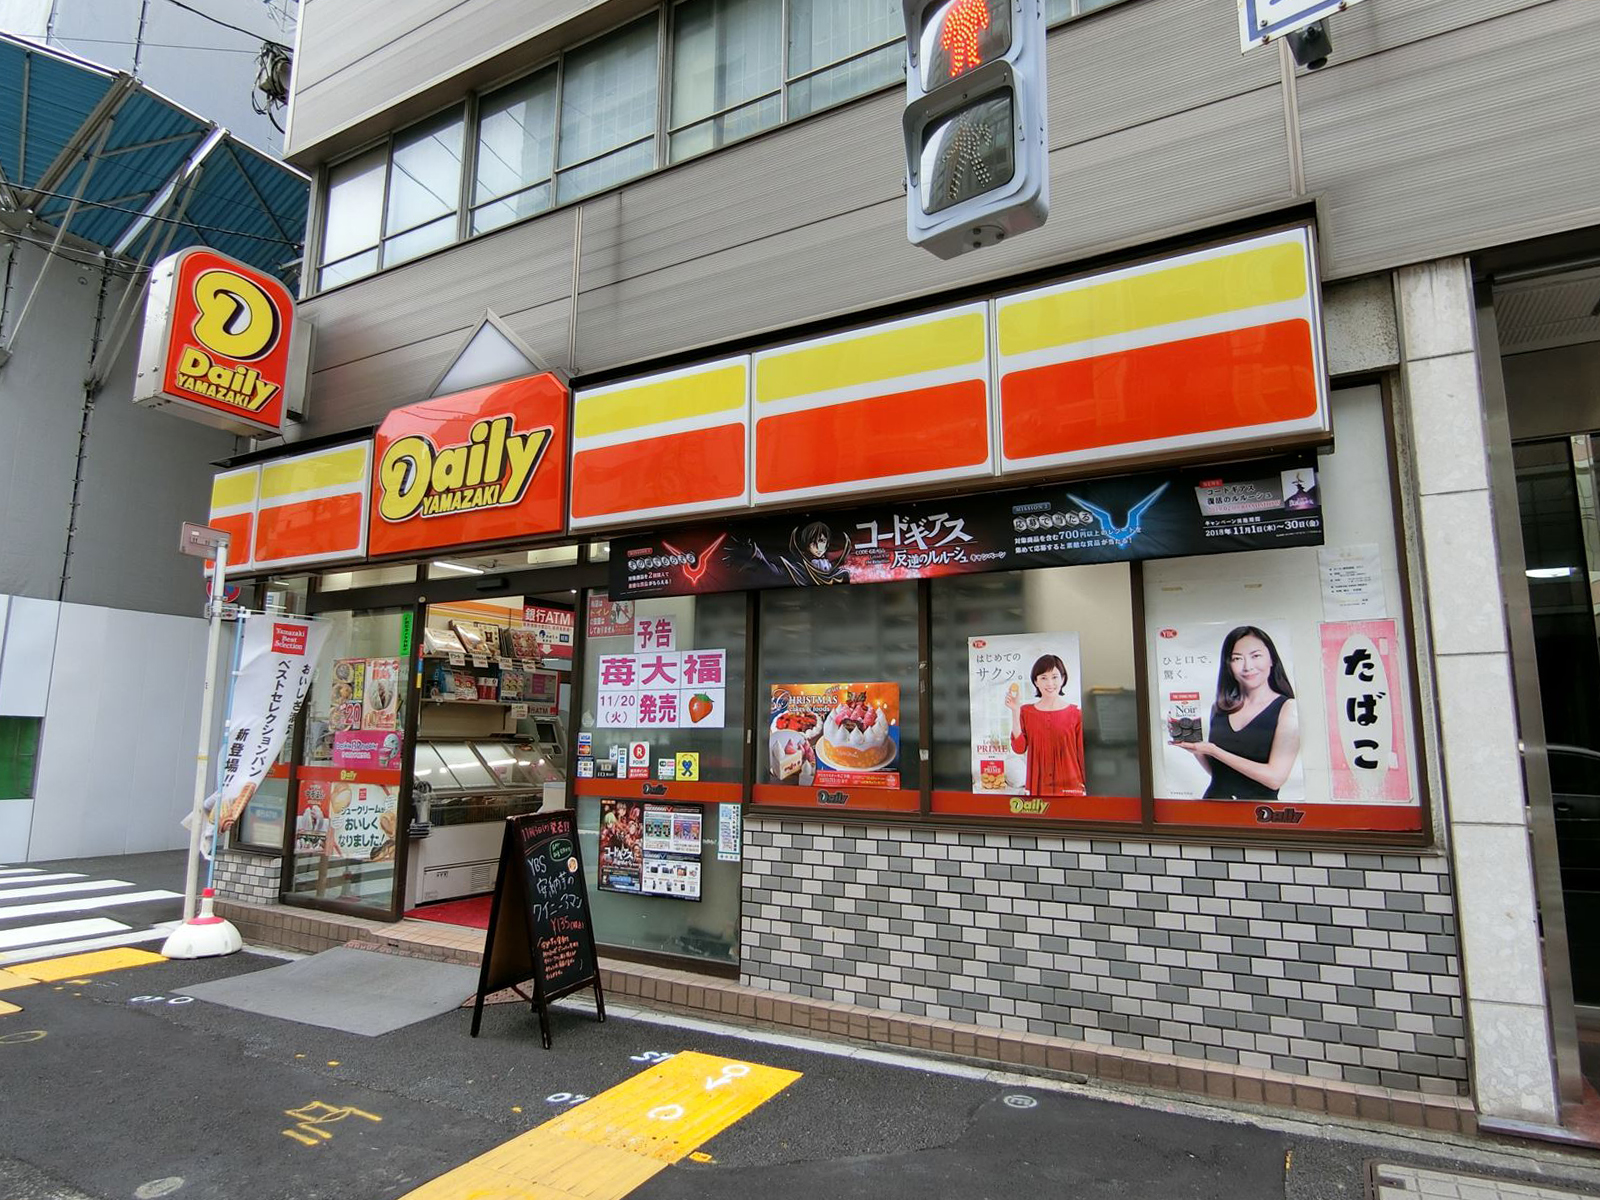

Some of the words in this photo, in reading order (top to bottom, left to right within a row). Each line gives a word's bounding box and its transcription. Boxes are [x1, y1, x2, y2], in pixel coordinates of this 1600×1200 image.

[178, 346, 280, 411] Daily
[176, 371, 250, 407] YAMAZAKI
[379, 417, 554, 523] Daily
[422, 484, 501, 516] YAMAZAKI
[854, 512, 975, 550] コードギアス
[891, 546, 968, 569] 反逆のルルーシュ
[525, 607, 571, 626] 銀行ATM
[276, 627, 305, 637] Yamazaki
[637, 618, 673, 650] 予告
[274, 640, 303, 651] Selection
[976, 652, 1022, 663] はじめての
[601, 653, 723, 687] 苺大福
[600, 694, 636, 708] 11/20
[639, 692, 678, 724] 発売
[1175, 704, 1198, 714] Noir
[1342, 648, 1387, 770] たばこ
[249, 659, 291, 778] ベストセレクションパン
[605, 710, 628, 724] (火)
[221, 727, 250, 787] 新登場!!
[977, 744, 1008, 753] PRIME
[817, 789, 849, 805] Daily
[1009, 796, 1050, 814] Daily
[344, 816, 379, 831] おいしく
[1255, 805, 1304, 824] Daily
[337, 833, 386, 848] なりました!
[528, 854, 547, 876] YBS
